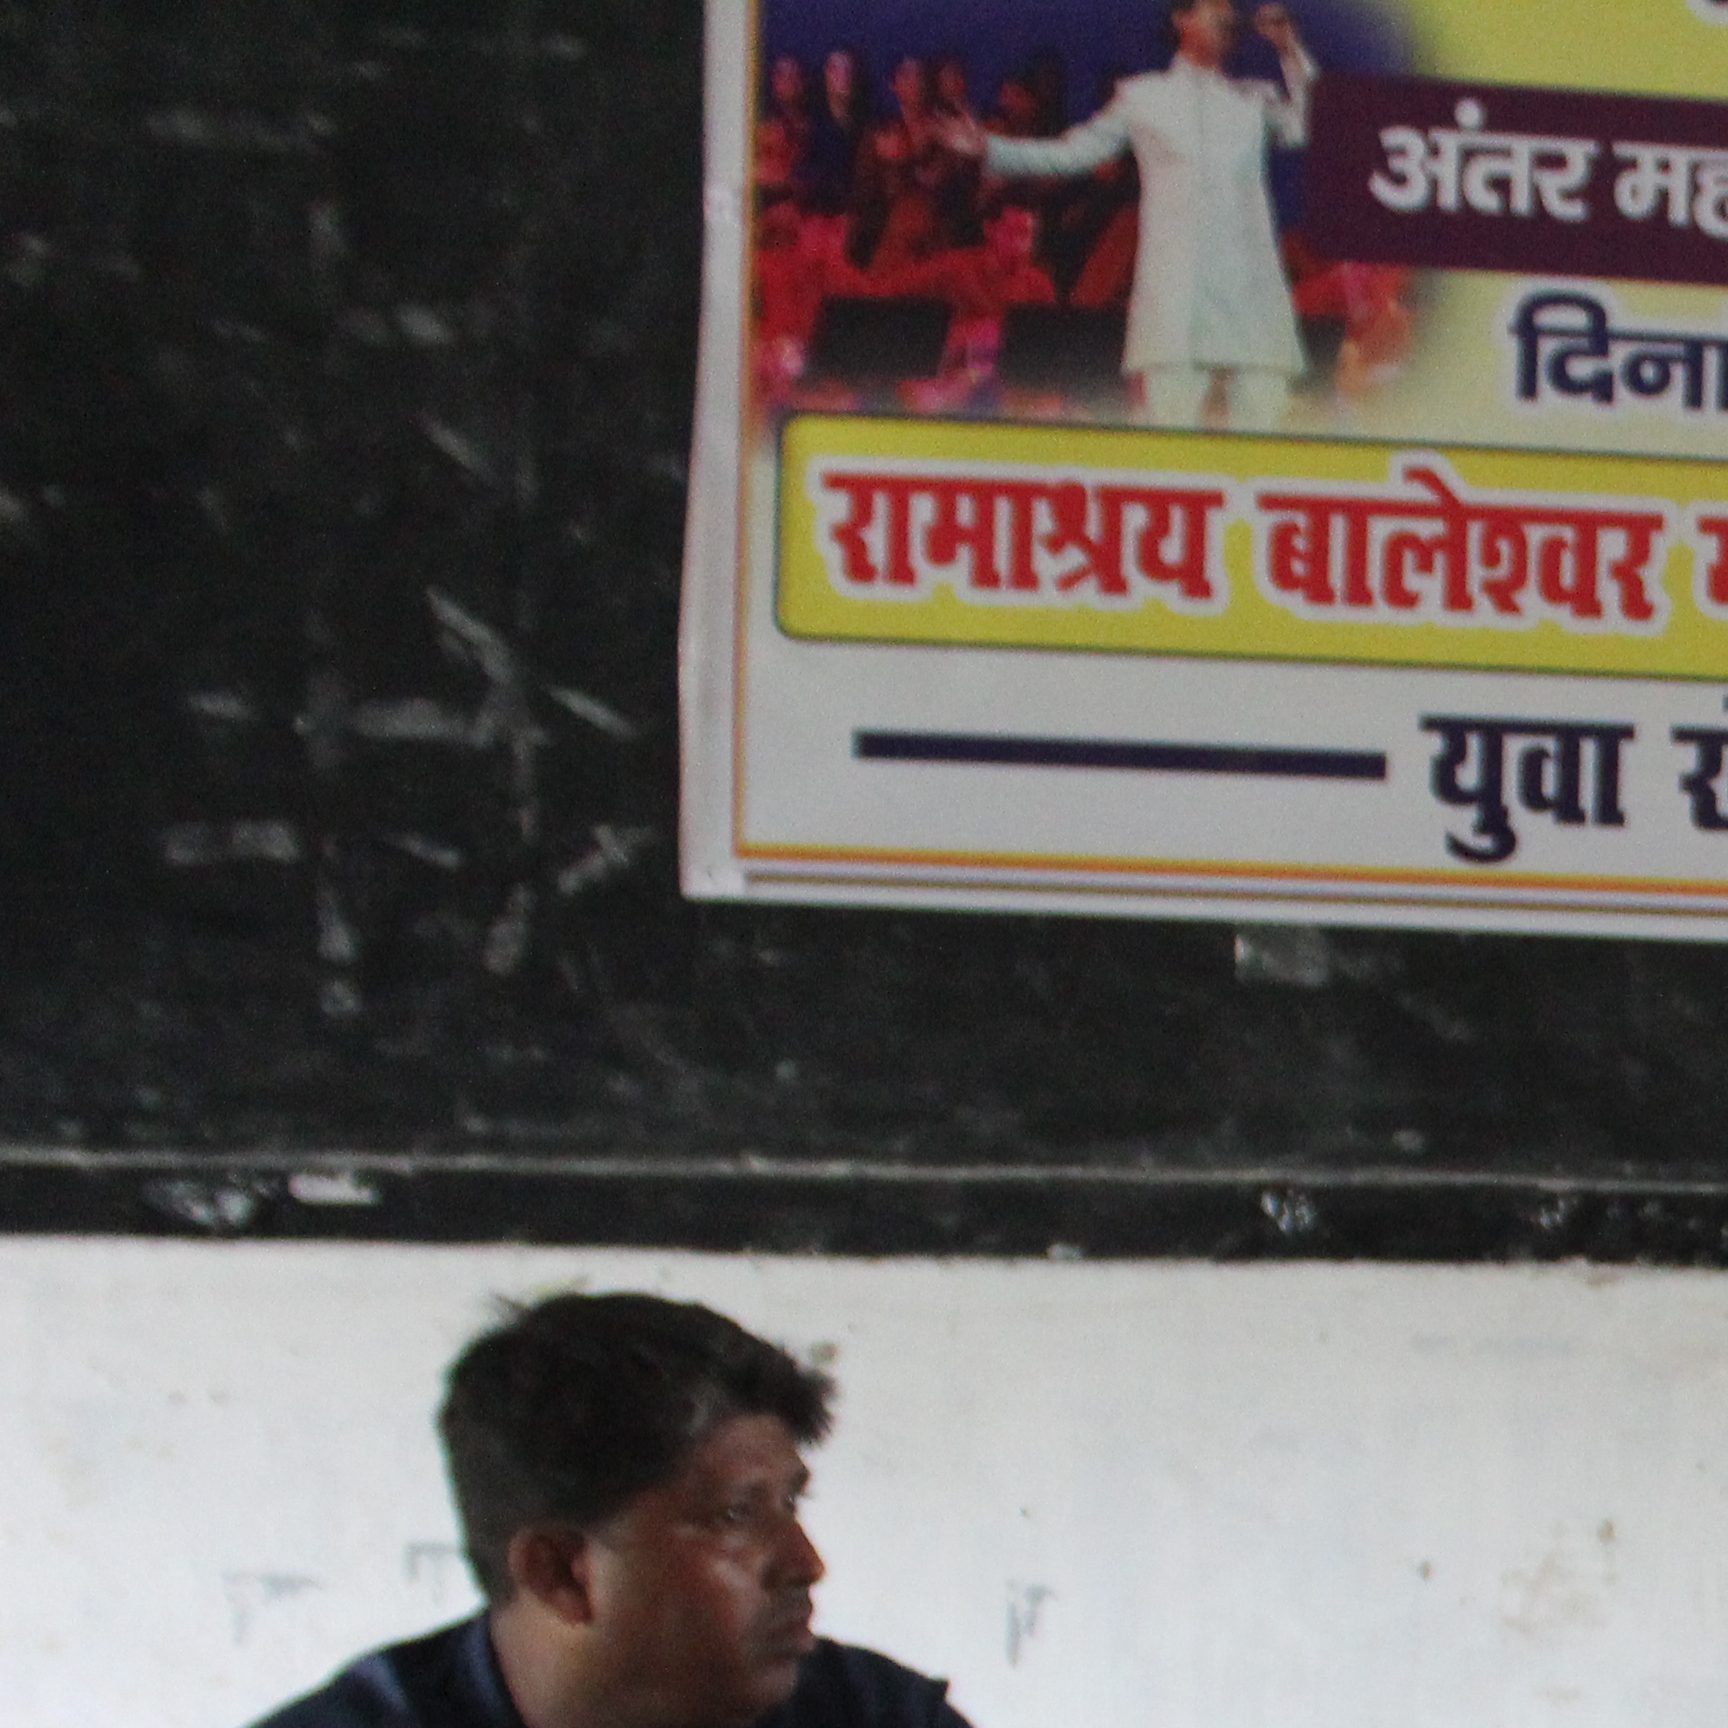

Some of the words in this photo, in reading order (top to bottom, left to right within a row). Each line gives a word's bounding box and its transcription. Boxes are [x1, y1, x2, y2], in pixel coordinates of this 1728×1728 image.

[1369, 100, 1596, 222] अंतर
[823, 472, 1225, 599] रामाश्रय
[1257, 467, 1663, 619] बालेश्वर
[1420, 715, 1636, 862] युवा
